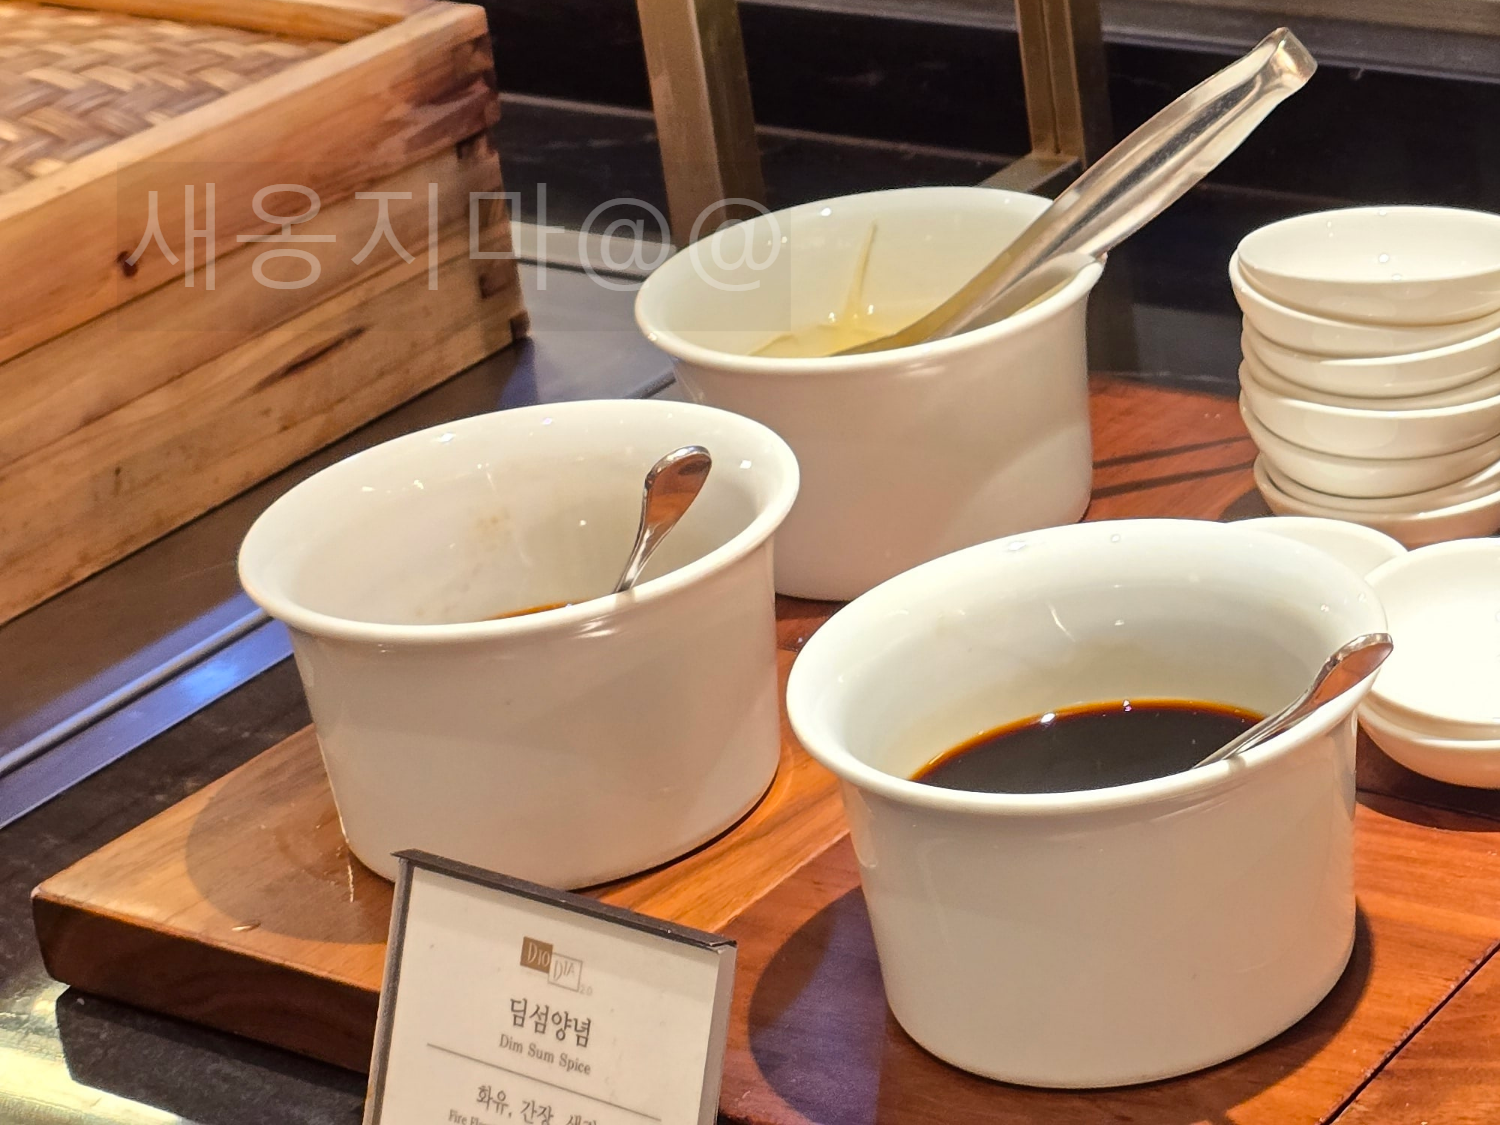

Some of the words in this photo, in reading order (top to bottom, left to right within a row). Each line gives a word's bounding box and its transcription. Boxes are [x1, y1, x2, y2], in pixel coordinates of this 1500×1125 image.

[509, 997, 592, 1048] 딤섬양념
[499, 1032, 524, 1054] Dim
[527, 1042, 555, 1064] Sum
[558, 1053, 591, 1076] Spice
[476, 1085, 512, 1118] 화유,
